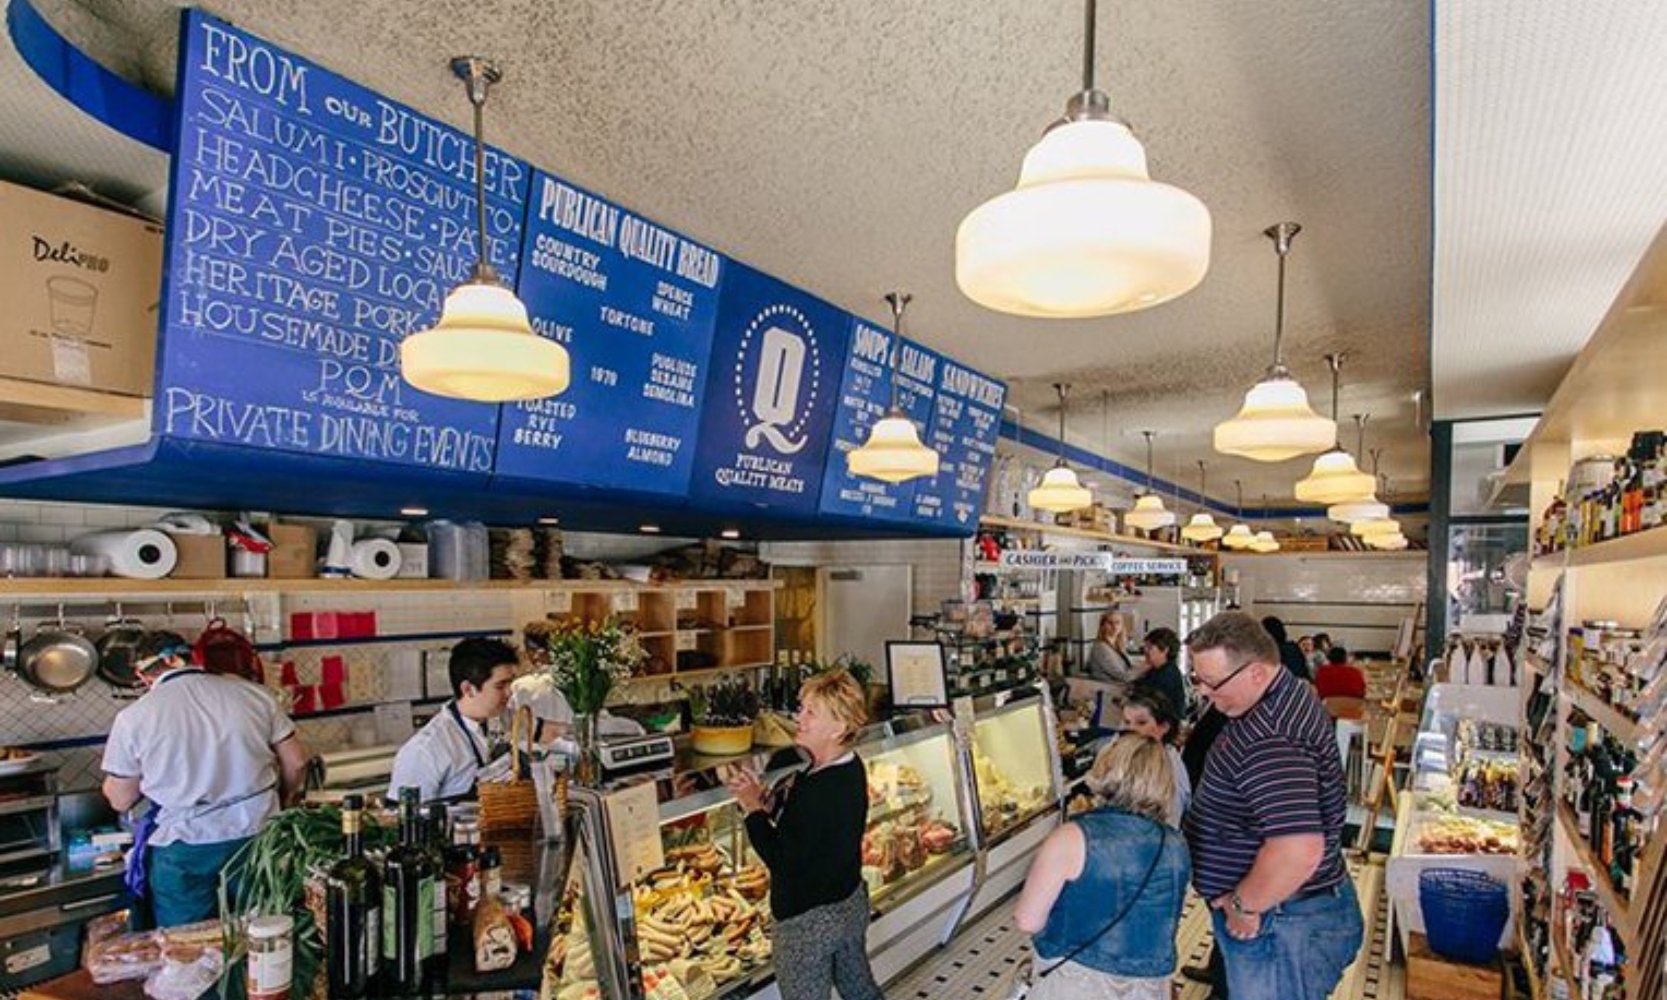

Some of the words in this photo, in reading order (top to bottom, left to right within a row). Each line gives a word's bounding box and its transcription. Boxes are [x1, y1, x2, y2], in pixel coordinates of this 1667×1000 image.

[199, 88, 346, 170] SALUMI
[201, 23, 311, 115] FROM
[324, 96, 372, 128] OUR
[376, 101, 522, 204] BUTCHER
[193, 129, 424, 240] HEADCHEESE
[188, 169, 311, 233] MEAT
[325, 216, 403, 262] PIES
[539, 177, 619, 248] PUBLICAN
[619, 214, 679, 271] QUALITY
[676, 239, 720, 289] BREAD
[184, 208, 266, 259] DRY
[269, 234, 371, 290] AGED
[378, 265, 450, 313] LOCA
[535, 233, 600, 270] COUNTRY
[182, 249, 340, 319] HERITAGE
[531, 249, 607, 292] SOURDOUGH
[600, 305, 655, 337] TORTONE
[651, 295, 691, 321] WHEAT
[180, 291, 369, 362] HOUSEMADE
[532, 316, 573, 343] OLIVE
[642, 383, 695, 409] SEMOLINA
[746, 326, 808, 454] Q
[322, 393, 389, 417] AVAILABLE
[393, 408, 420, 423] FOR
[516, 399, 577, 419] TOASTED
[529, 413, 557, 432] RYE
[165, 387, 312, 447] PRIVATE
[319, 414, 410, 457] DINING
[414, 426, 495, 471] EVENTS
[513, 428, 563, 450] BERRY
[625, 428, 681, 452] BLUEBERRY
[627, 446, 674, 468] ALMOND
[735, 453, 793, 475] PUBLICAN
[715, 467, 767, 488] QUALITY
[768, 474, 804, 493] MEATS
[1005, 553, 1057, 567] CASHIER
[1147, 562, 1182, 574] SERVICE
